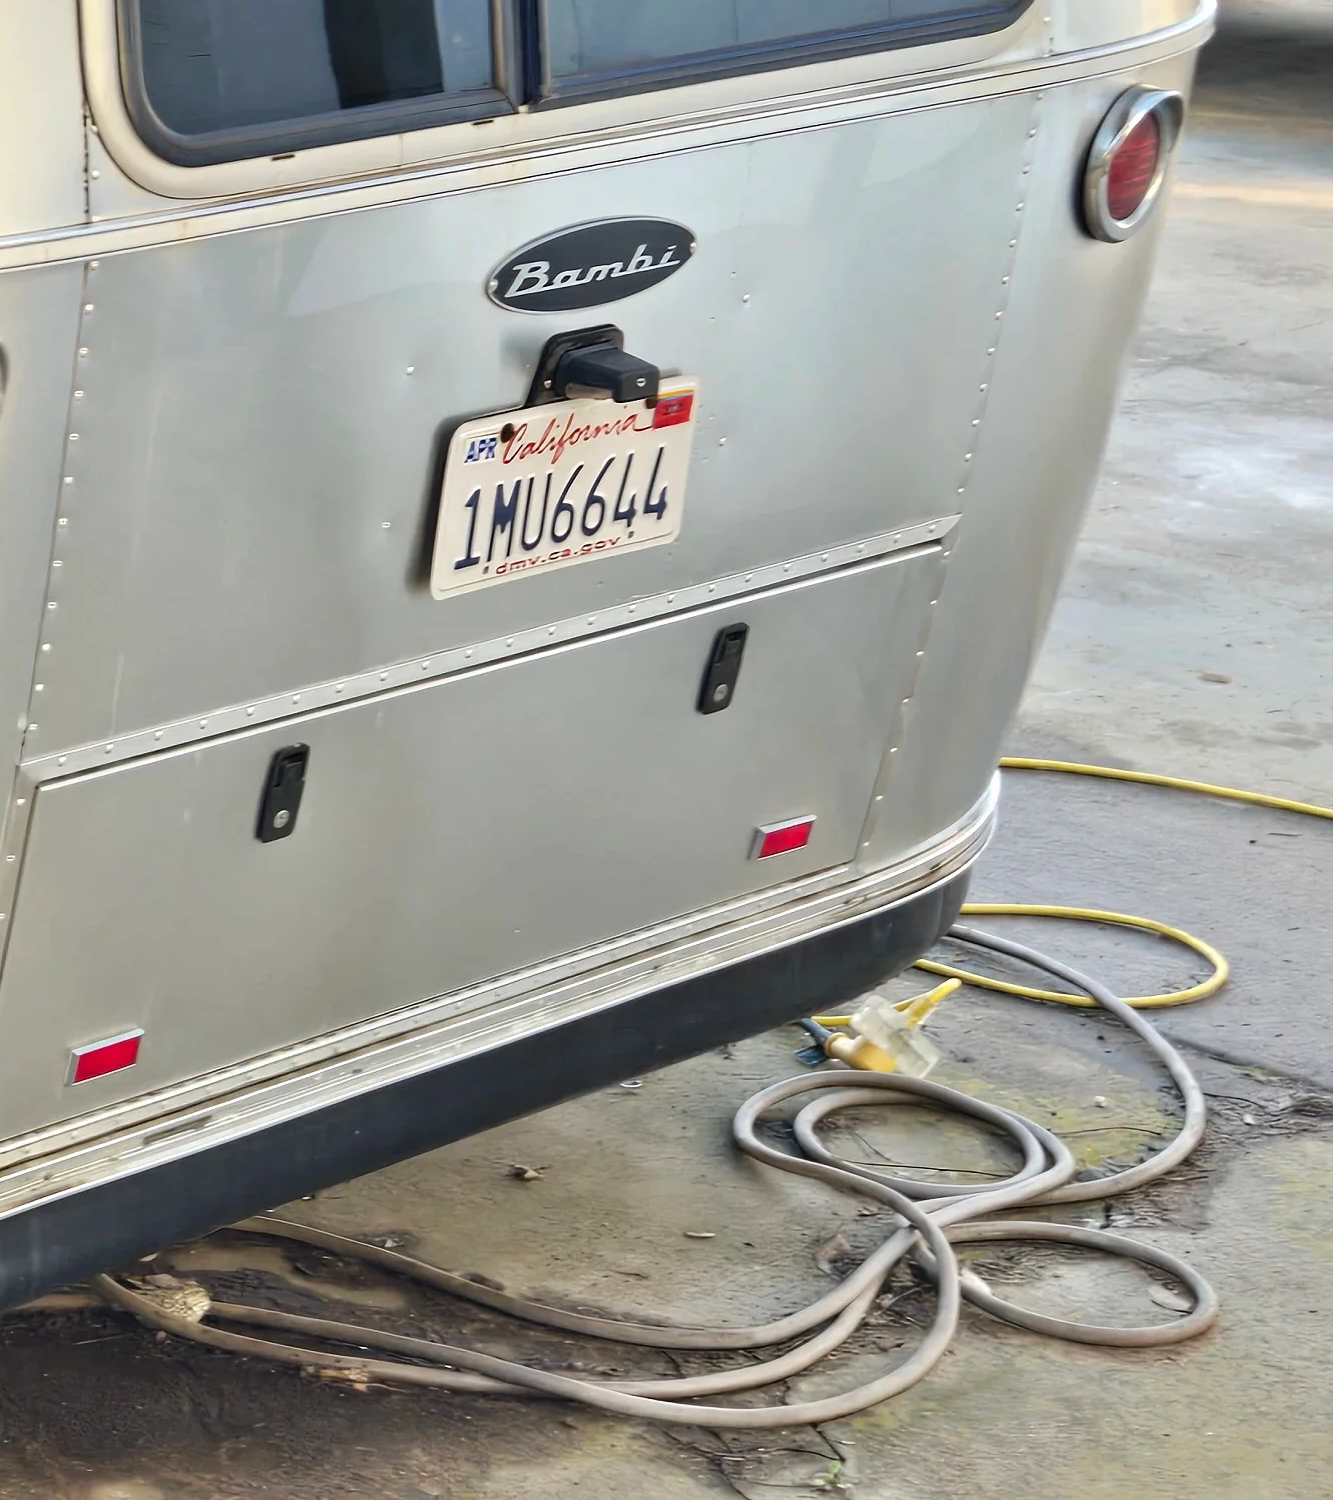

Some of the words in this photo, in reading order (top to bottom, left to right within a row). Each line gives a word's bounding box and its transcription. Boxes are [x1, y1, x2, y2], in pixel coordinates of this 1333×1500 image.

[504, 243, 682, 298] Bambi
[463, 436, 499, 464] APR
[501, 404, 655, 466] California
[452, 444, 669, 571] 1MU6644
[495, 536, 621, 575] dmv.ca.gov
